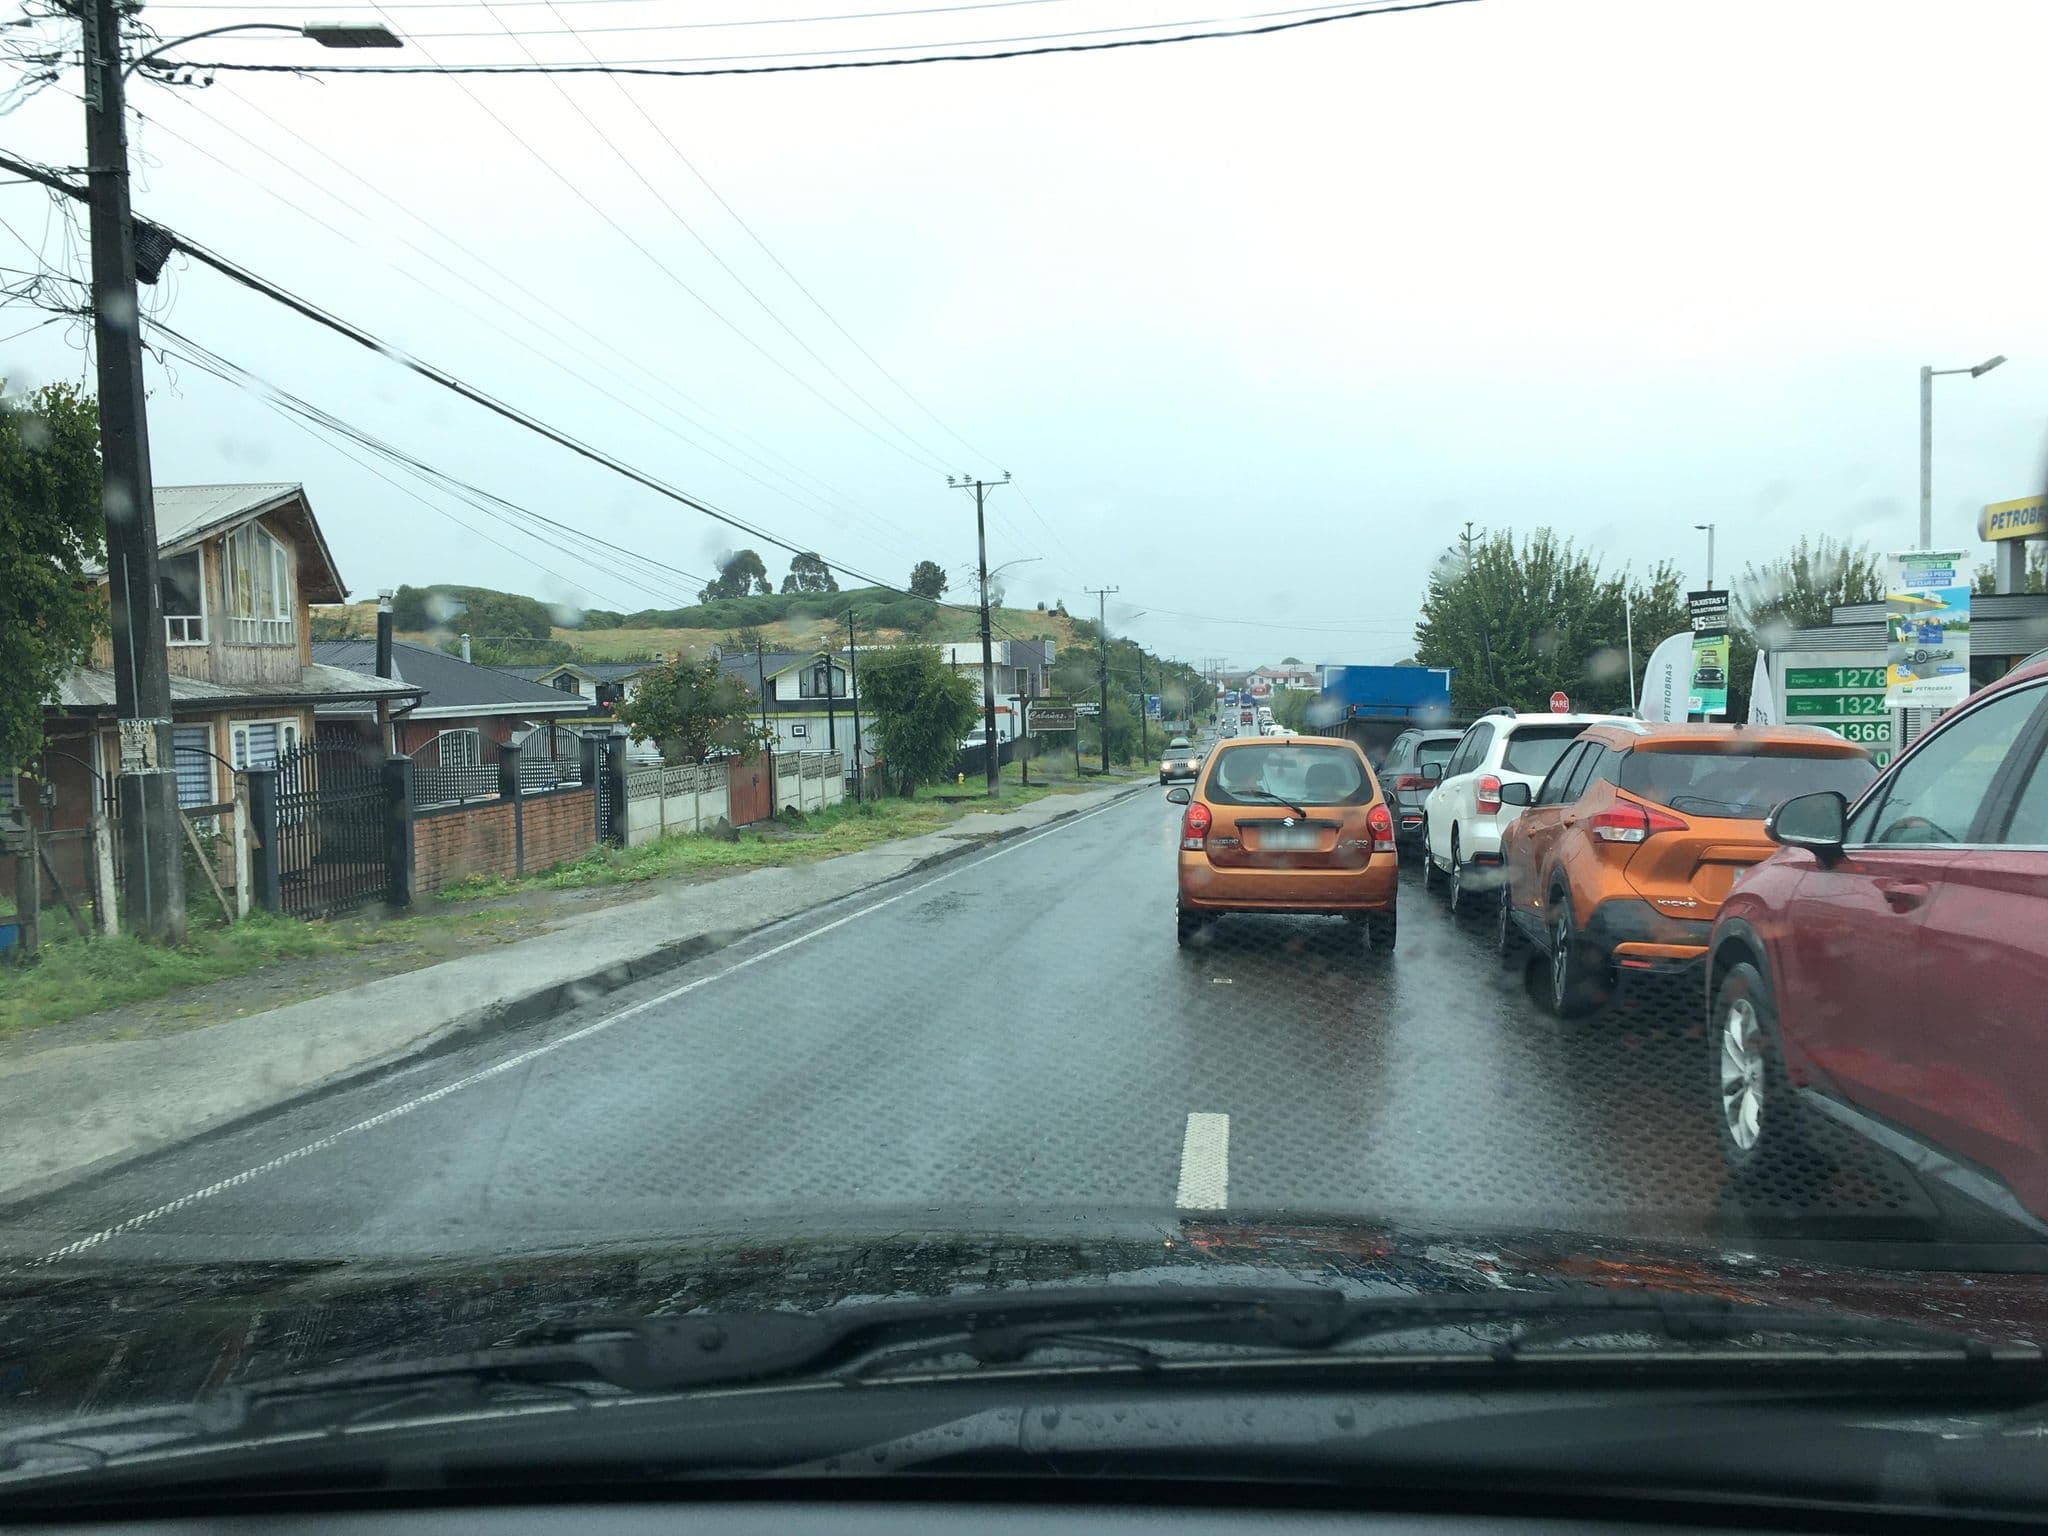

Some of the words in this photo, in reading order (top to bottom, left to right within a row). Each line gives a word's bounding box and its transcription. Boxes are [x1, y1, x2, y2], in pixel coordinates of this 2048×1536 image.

[1834, 669, 1887, 688] 1278
[1663, 663, 1673, 722] PETROBRAS
[1551, 700, 1568, 708] PARE
[1835, 696, 1889, 715] 1324
[1836, 723, 1890, 741] 1366
